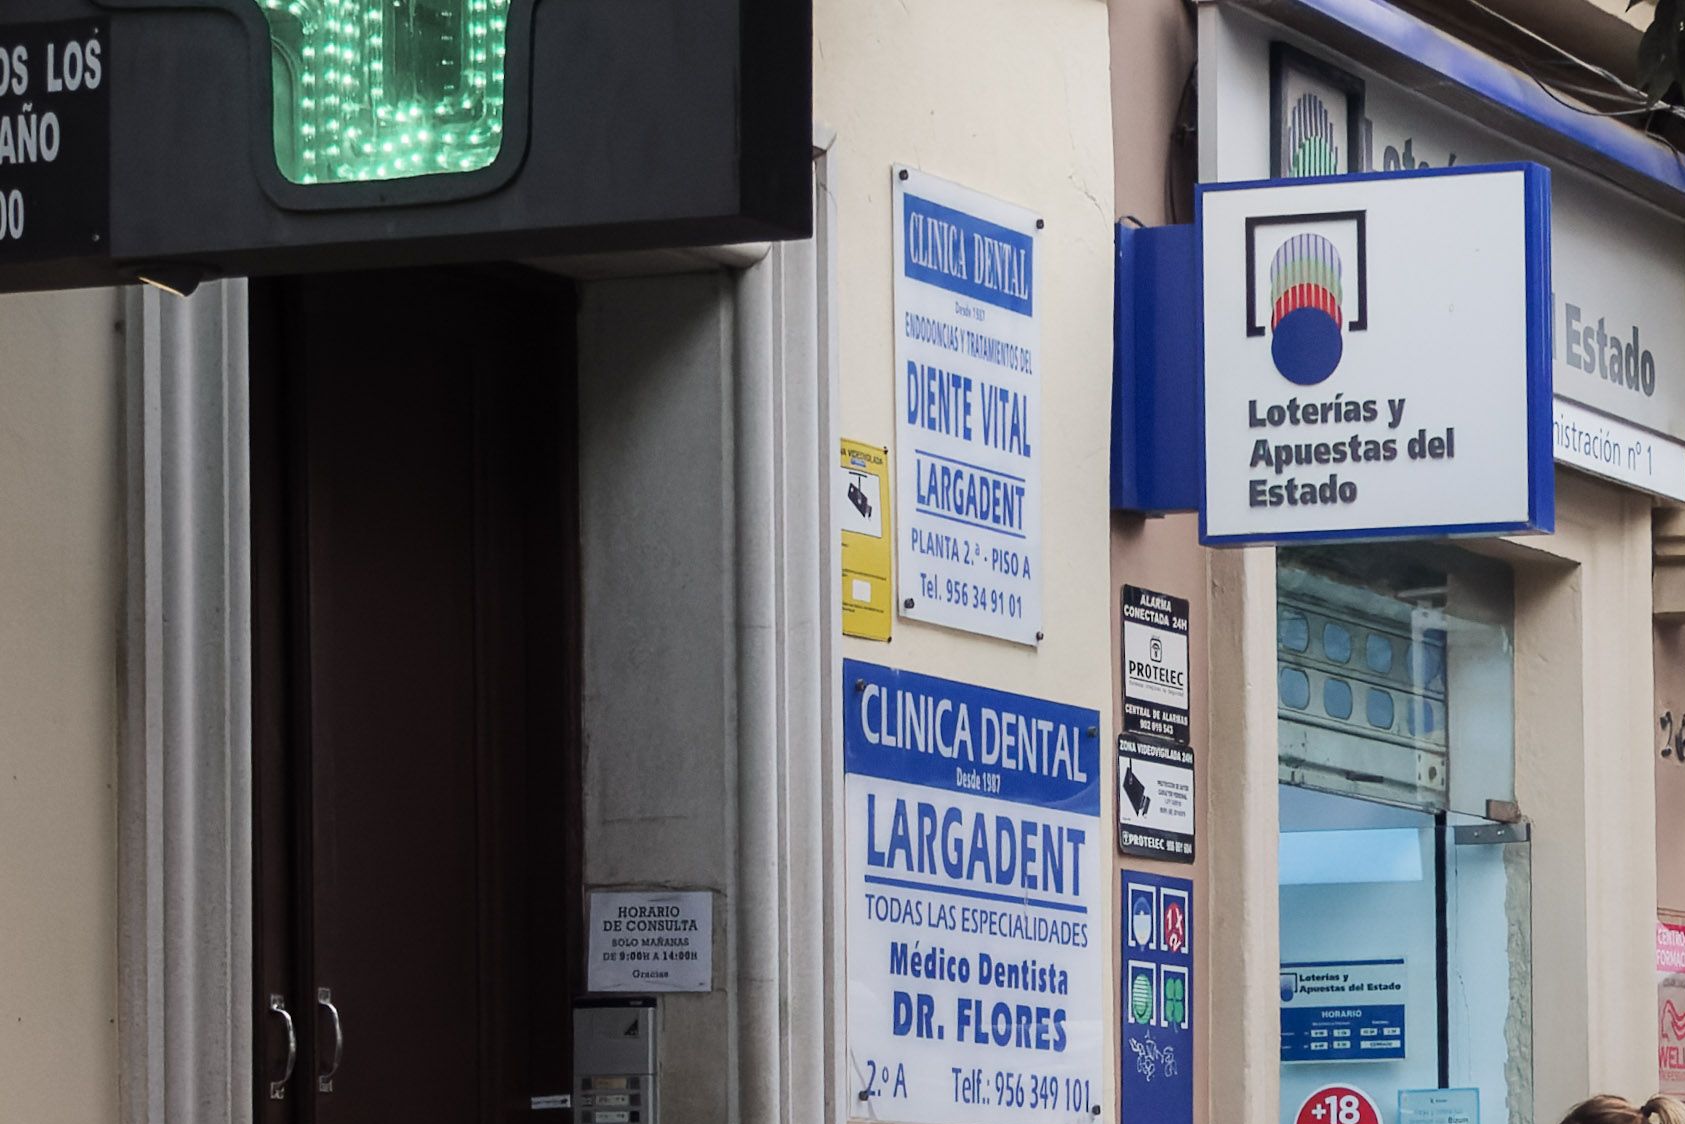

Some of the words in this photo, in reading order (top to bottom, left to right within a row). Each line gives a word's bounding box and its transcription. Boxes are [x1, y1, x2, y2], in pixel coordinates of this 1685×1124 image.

[47, 39, 102, 92] LOS
[909, 212, 967, 280] CLINICA
[973, 233, 1028, 300] DENTAL
[905, 312, 959, 351] ENDODONCIAS
[960, 329, 965, 352] Y
[966, 331, 1018, 369] TRATAMIENTOS
[1020, 348, 1032, 375] DEL
[1565, 303, 1656, 397] Estado
[907, 360, 972, 441] DIENTE
[981, 382, 1031, 458] VITAL
[1248, 393, 1378, 428] Loterías
[1387, 397, 1406, 428] y
[1249, 431, 1398, 474] Apuestas
[1407, 428, 1455, 460] del
[1647, 445, 1652, 476] 1
[916, 459, 1025, 530] LARGADENT
[1248, 473, 1358, 508] Estado
[911, 527, 959, 563] PLANTA
[992, 548, 1018, 577] PISO
[1023, 555, 1031, 580] A
[920, 573, 941, 601] Tel.
[946, 579, 968, 607] 956
[972, 586, 987, 612] 34
[991, 589, 1004, 615] 91
[1009, 593, 1022, 619] 01
[1140, 594, 1171, 613] ALARMA
[1123, 604, 1169, 627] CONECTADA
[1172, 616, 1187, 631] 24H
[1129, 660, 1183, 686] PROTELEC
[1125, 704, 1151, 718] CENTRAL
[1152, 709, 1160, 720] DE
[1162, 711, 1188, 726] ALARMAS
[861, 684, 974, 762] CLINICA
[981, 707, 1087, 783] DENTAL
[1120, 739, 1137, 753] ZONA
[956, 767, 981, 791] Desde
[983, 771, 1000, 794] 1987
[867, 794, 1086, 897] LARGADENT
[1129, 833, 1165, 850] PROTELEC
[603, 920, 622, 932] DE
[626, 919, 698, 931] CONSULTA
[618, 906, 680, 918] HORARIO
[865, 893, 922, 927] TODAS
[928, 904, 956, 932] LAS
[961, 907, 1088, 948] ESPECIALIDADES
[603, 952, 616, 961] DE
[653, 952, 660, 961] A
[612, 938, 639, 947] SOLO
[641, 936, 690, 947] MAÑANAS
[632, 969, 669, 978] Gracias
[889, 940, 970, 984] Médico
[978, 952, 1068, 995] Dentista
[1299, 972, 1339, 982] Loterías
[1343, 973, 1349, 983] y
[1299, 983, 1348, 994] Apuestas
[1351, 983, 1365, 992] del
[1366, 982, 1401, 992] Estado
[893, 990, 944, 1040] DR.
[957, 998, 1067, 1053] FLORES
[1321, 1009, 1362, 1019] HORARIO
[893, 1062, 907, 1099] A
[952, 1067, 990, 1105] Telf.:
[995, 1071, 1024, 1109] 956
[1030, 1074, 1058, 1110] 349
[1065, 1078, 1090, 1113] 101
